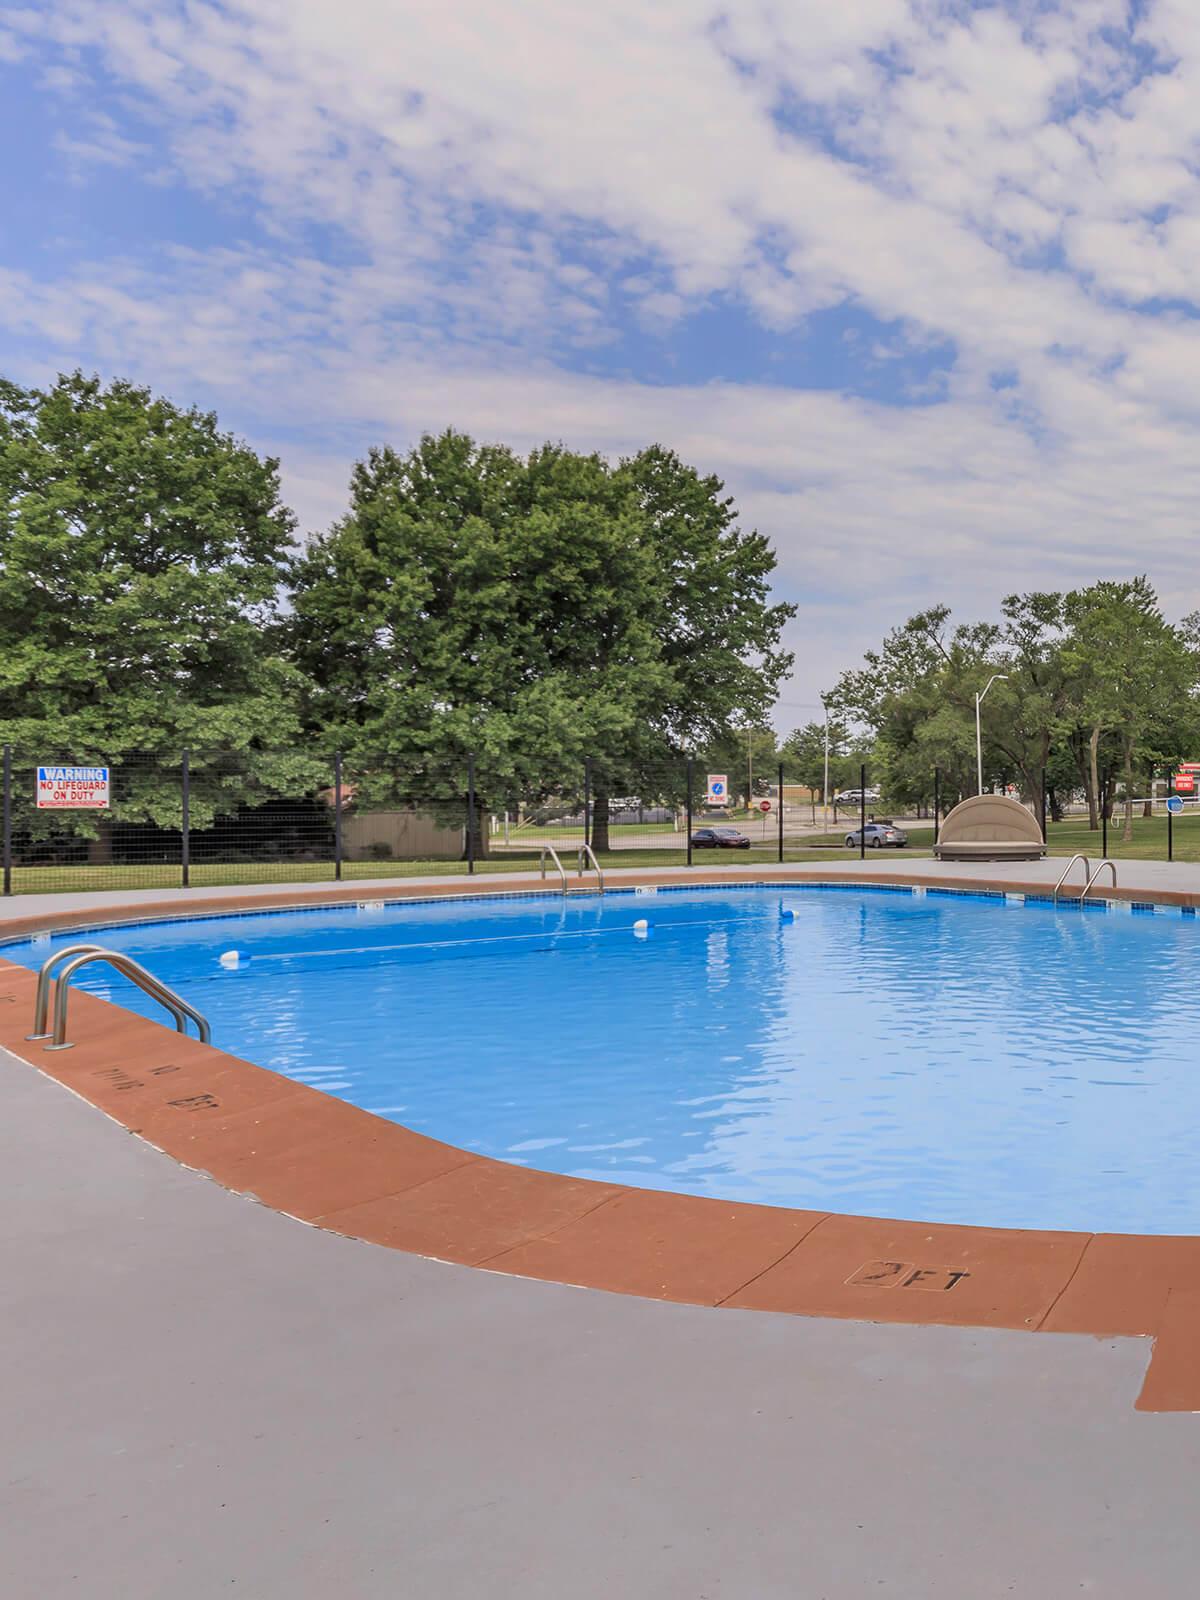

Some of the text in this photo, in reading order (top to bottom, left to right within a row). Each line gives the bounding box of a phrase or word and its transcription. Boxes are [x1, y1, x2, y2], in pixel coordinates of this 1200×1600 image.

[44, 768, 104, 780] WARNING
[40, 781, 106, 790] NO LIFEGUARD
[53, 791, 95, 800] ON DUTY
